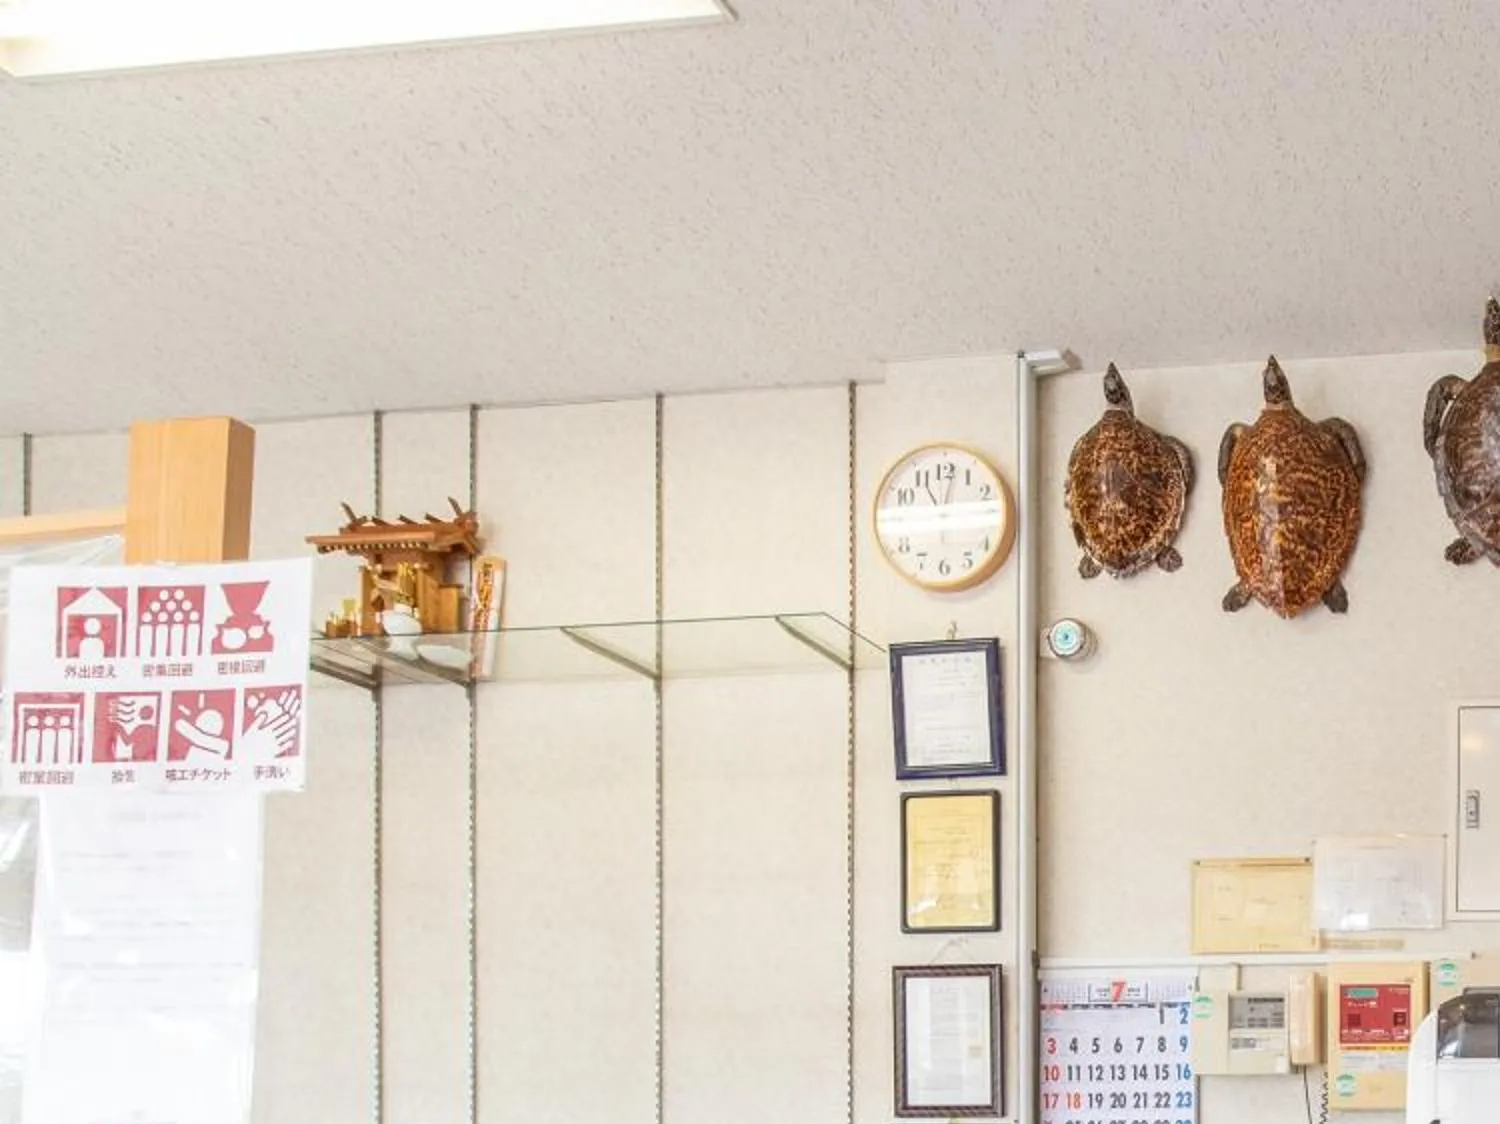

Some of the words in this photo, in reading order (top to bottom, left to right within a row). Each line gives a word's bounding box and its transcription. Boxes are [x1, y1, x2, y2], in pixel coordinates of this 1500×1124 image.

[937, 463, 955, 480] 12
[966, 469, 970, 485] 1
[898, 488, 914, 504] 10
[980, 485, 991, 500] 2
[916, 553, 928, 570] 7
[939, 559, 950, 575] 6
[962, 552, 973, 568] 5
[1112, 982, 1125, 1002] 7
[1180, 1007, 1189, 1024] 2
[1047, 1037, 1056, 1053] 3
[1069, 1037, 1078, 1053] 4
[1092, 1037, 1100, 1053] 5
[1114, 1037, 1123, 1053] 6
[1136, 1037, 1144, 1053] 7
[1158, 1037, 1166, 1053] 8
[1180, 1037, 1188, 1053] 9
[1044, 1065, 1060, 1081] 10
[1067, 1065, 1081, 1081] 11
[1088, 1065, 1103, 1081] 12
[1110, 1065, 1125, 1081] 13
[1132, 1065, 1148, 1081] 14
[1154, 1065, 1169, 1081] 15
[1176, 1065, 1191, 1081] 16
[1044, 1093, 1059, 1109] 17
[1066, 1093, 1081, 1109] 18
[1088, 1093, 1103, 1109] 19
[1110, 1093, 1126, 1109] 20
[1132, 1093, 1148, 1109] 21
[1154, 1093, 1170, 1109] 22
[1176, 1093, 1192, 1109] 23
